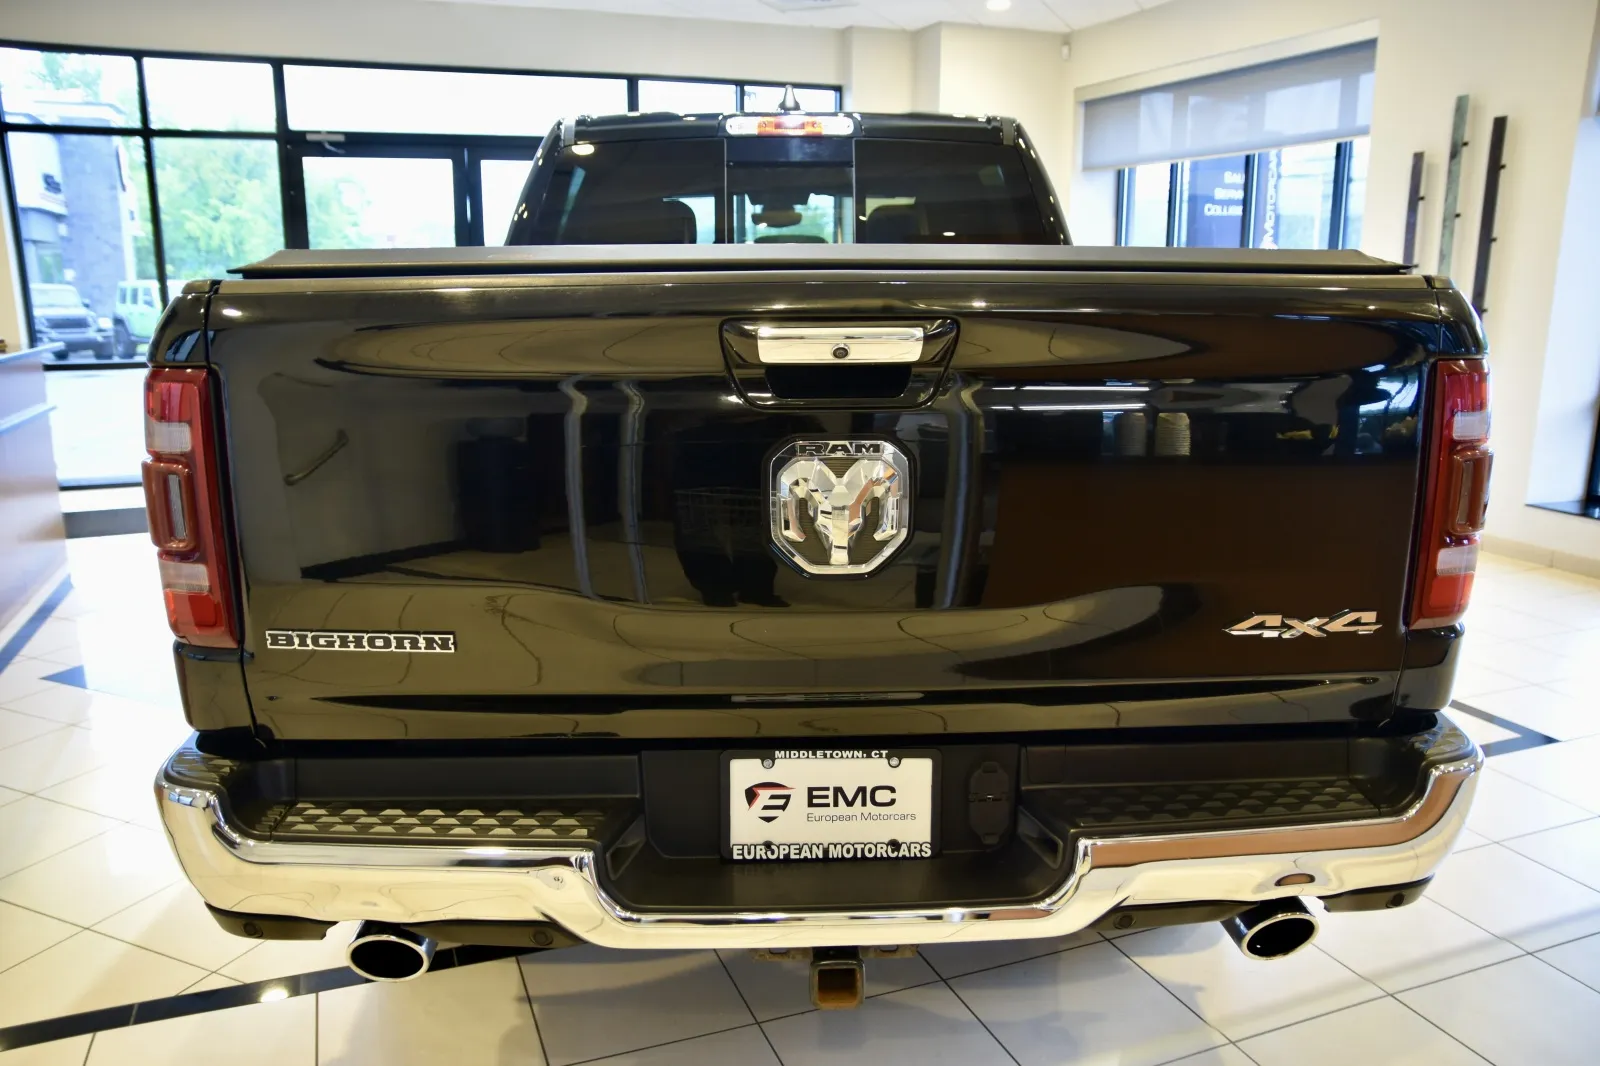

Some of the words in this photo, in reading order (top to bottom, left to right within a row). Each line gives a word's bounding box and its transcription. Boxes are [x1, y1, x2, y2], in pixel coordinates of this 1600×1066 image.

[798, 442, 882, 456] RAM
[265, 630, 456, 652] BIGHORN
[871, 750, 888, 758] CT
[807, 785, 897, 808] EMC
[806, 813, 858, 823] European
[860, 811, 917, 821] Motorcars
[732, 843, 824, 860] EUROPEAN
[828, 842, 932, 859] MOTORCARS
